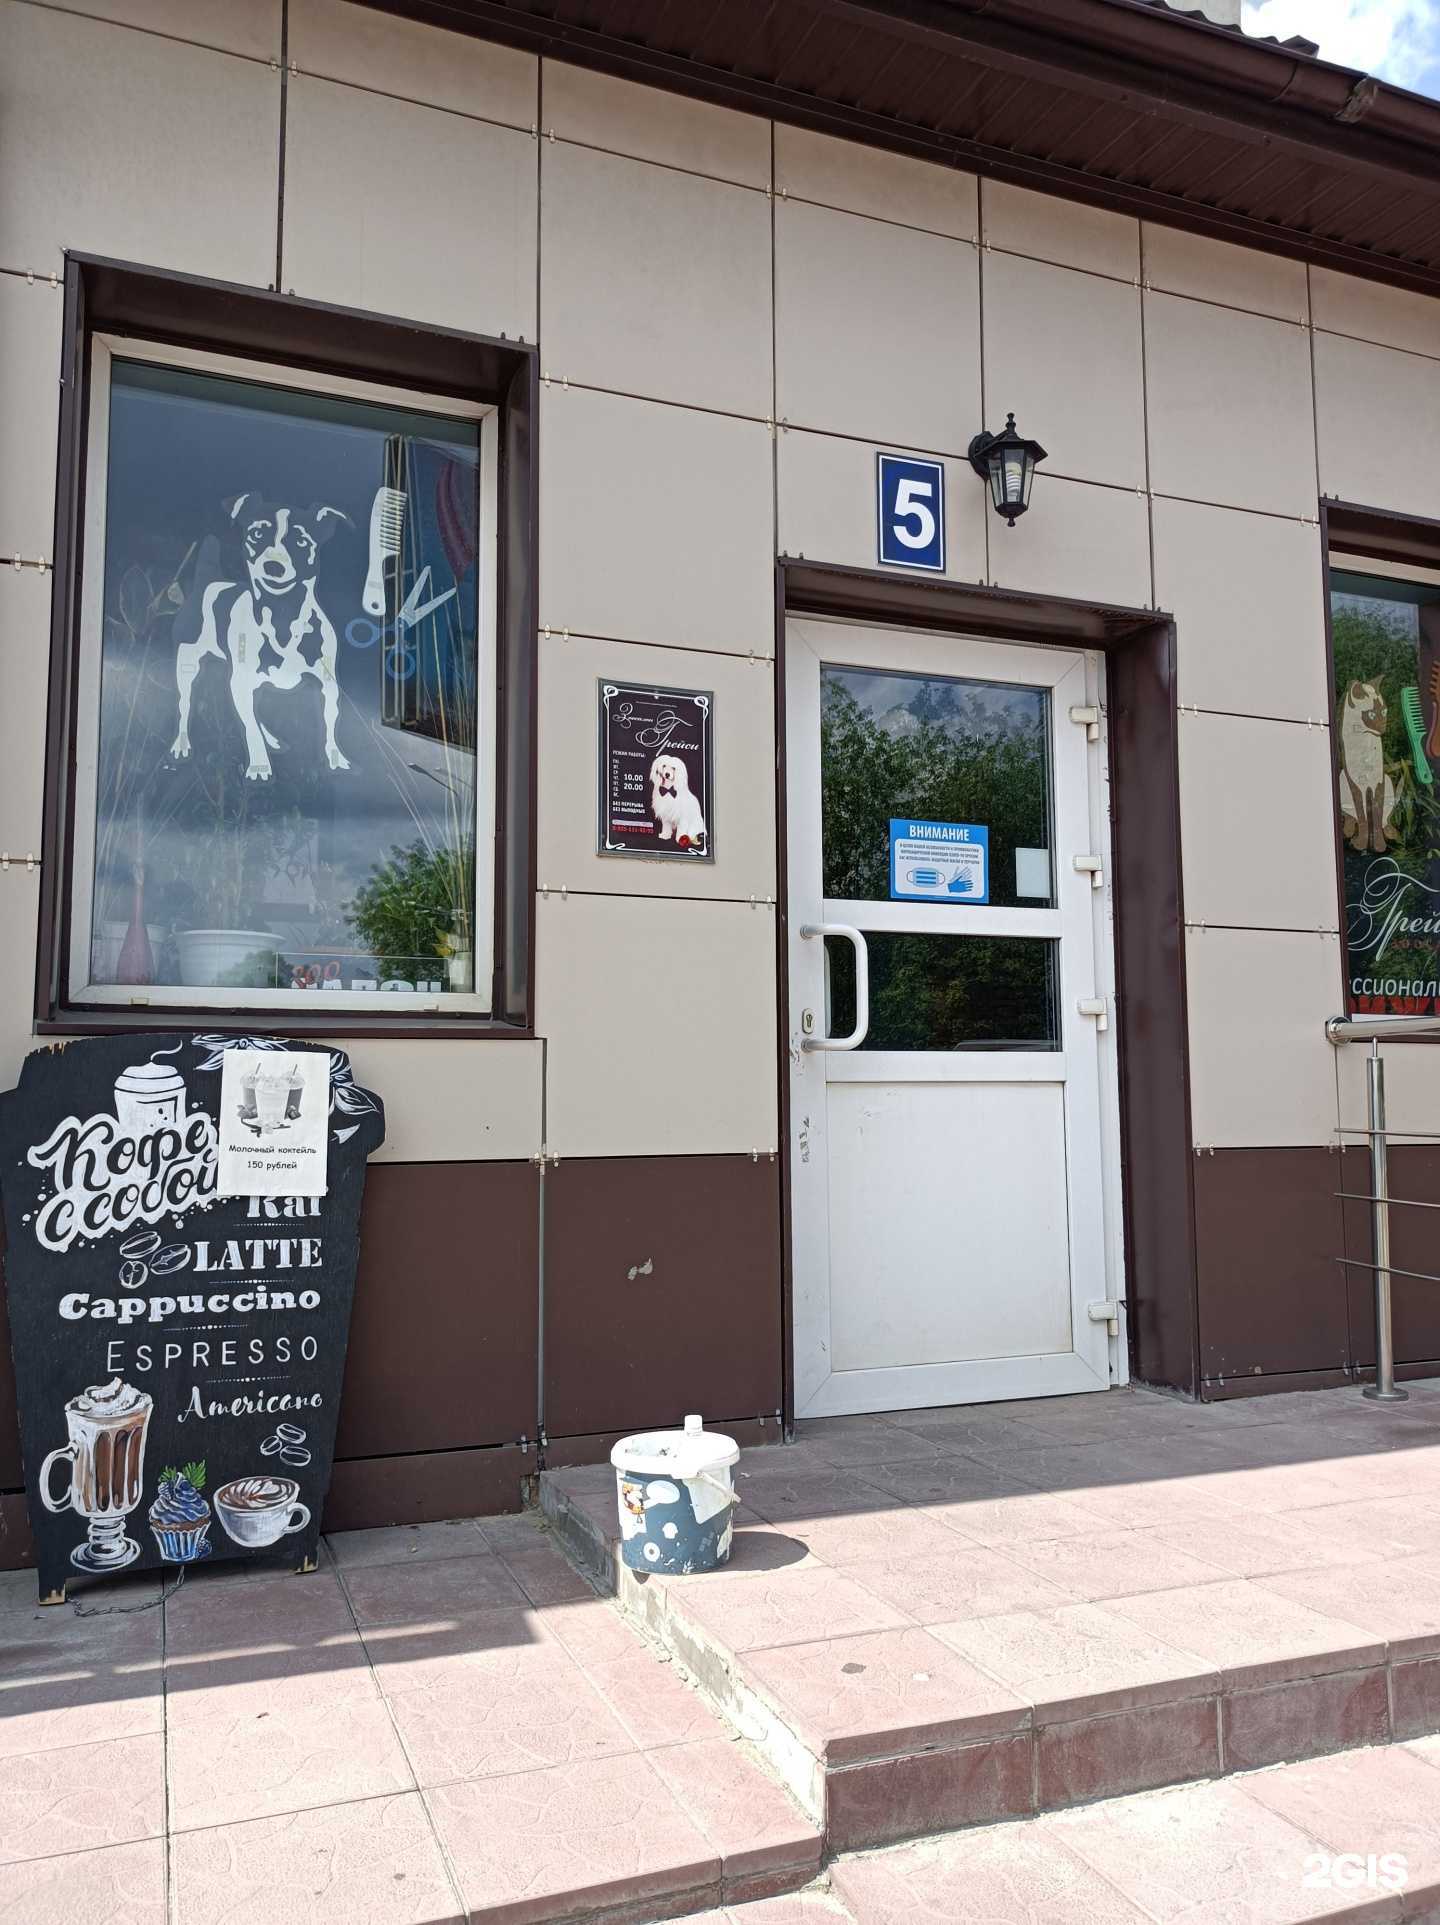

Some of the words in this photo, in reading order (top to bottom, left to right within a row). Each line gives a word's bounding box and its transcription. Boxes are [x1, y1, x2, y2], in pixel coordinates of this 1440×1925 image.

[893, 478, 935, 549] 5
[624, 774, 643, 782] 10.00
[624, 783, 643, 791] 20.00
[909, 825, 970, 841] ВНИМАНИЕ
[228, 1145, 275, 1154] Молочный
[247, 1161, 264, 1169] 150
[266, 1162, 298, 1171] рублей
[193, 1238, 323, 1271] LATTE
[58, 1285, 321, 1324] Cappuccino
[107, 1336, 318, 1372] ESPRESSO
[177, 1386, 323, 1423] Americano
